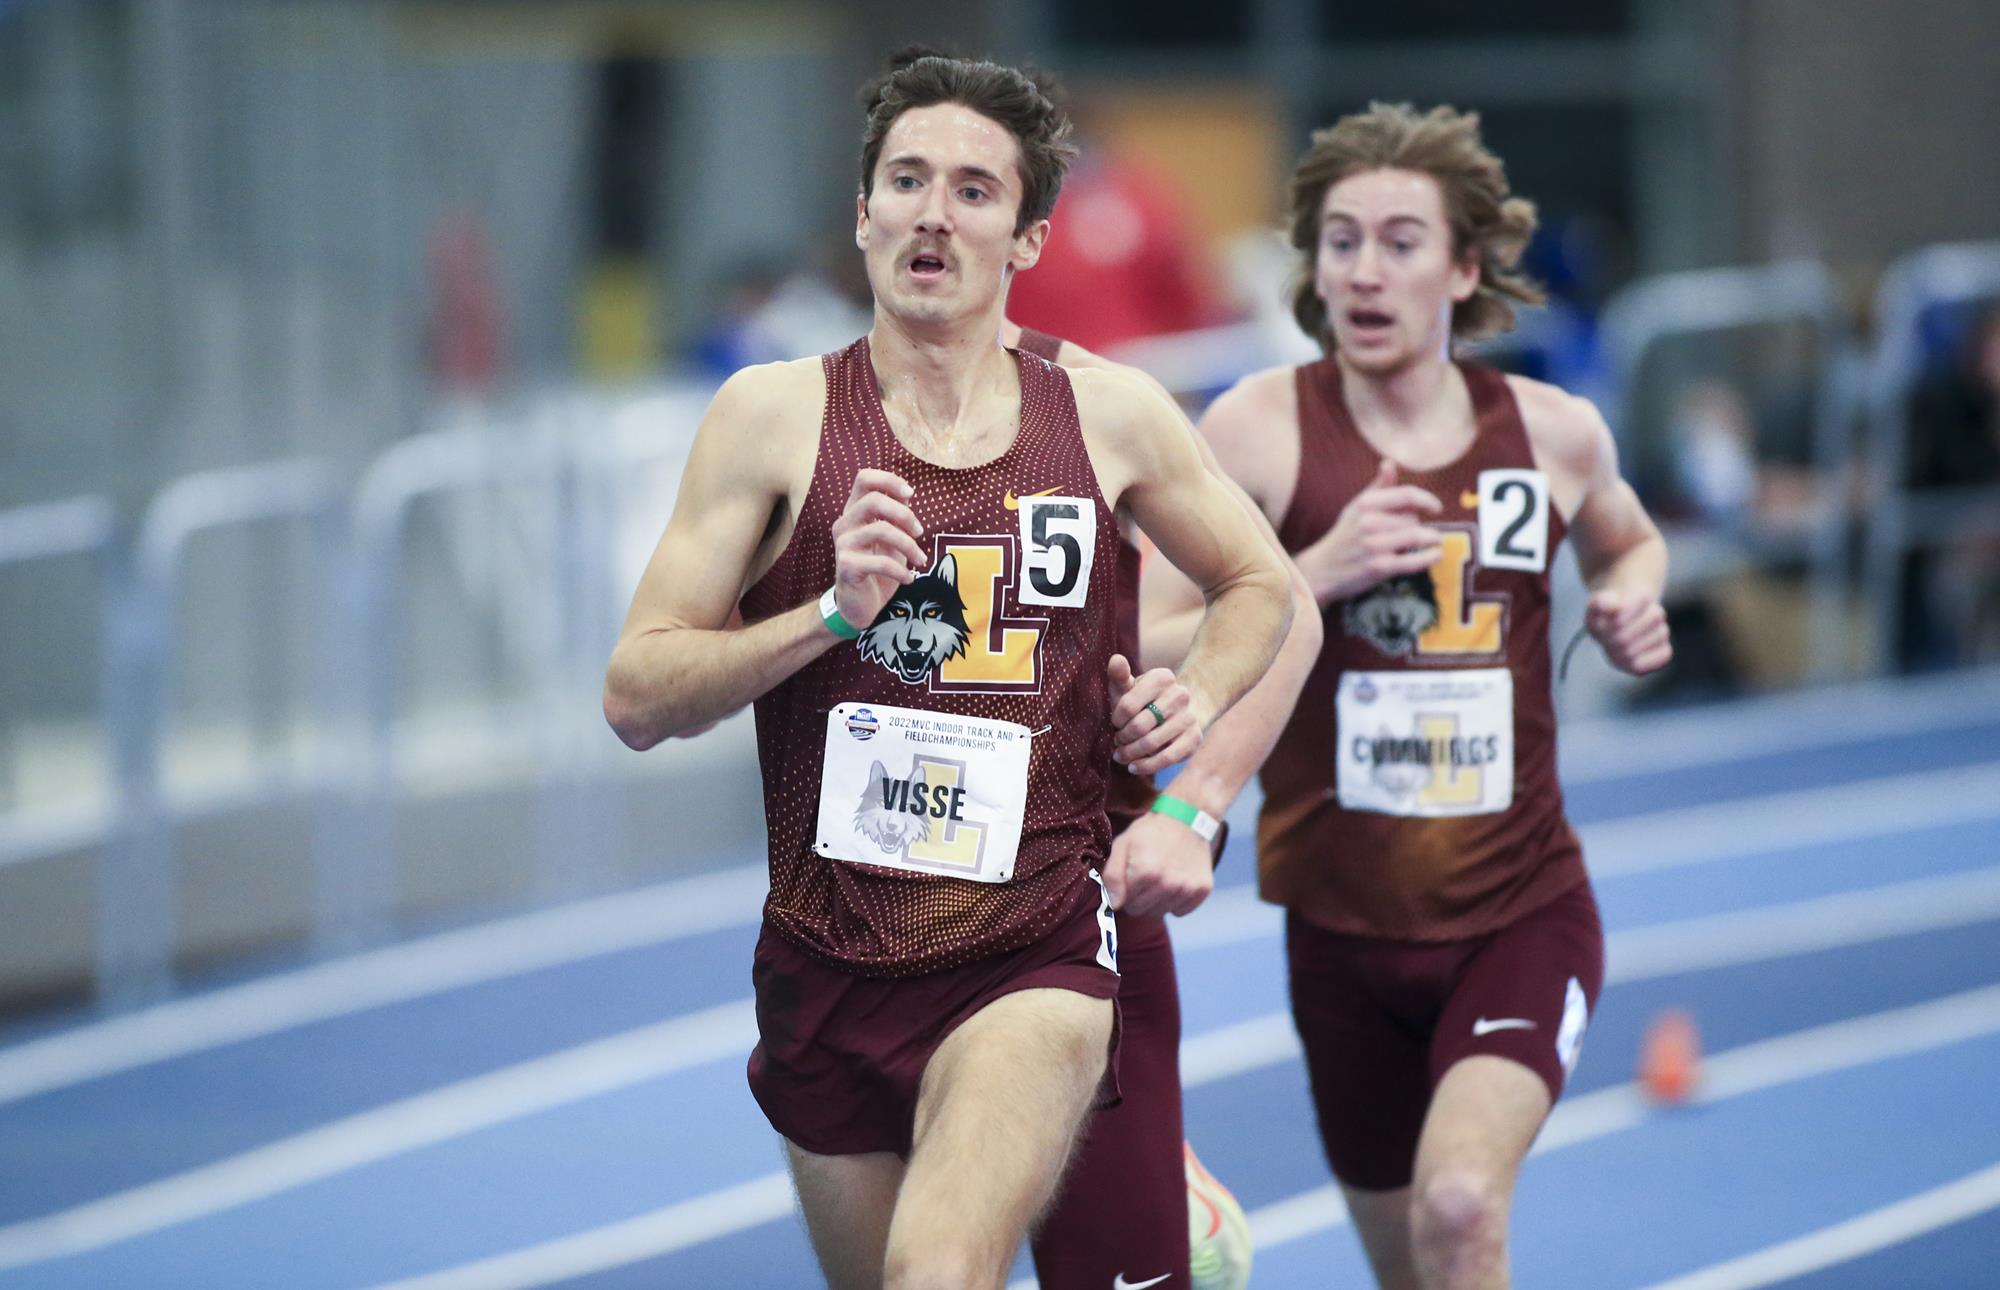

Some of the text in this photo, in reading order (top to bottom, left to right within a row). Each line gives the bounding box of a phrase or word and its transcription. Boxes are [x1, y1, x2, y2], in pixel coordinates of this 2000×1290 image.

[1028, 503, 1082, 597] 5
[1492, 480, 1536, 559] 2
[929, 534, 1050, 694] L
[1406, 522, 1512, 664] L
[932, 722, 964, 736] INDOOR
[967, 725, 994, 739] TRACK
[996, 728, 1014, 742] AND
[882, 776, 967, 821] VISSE
